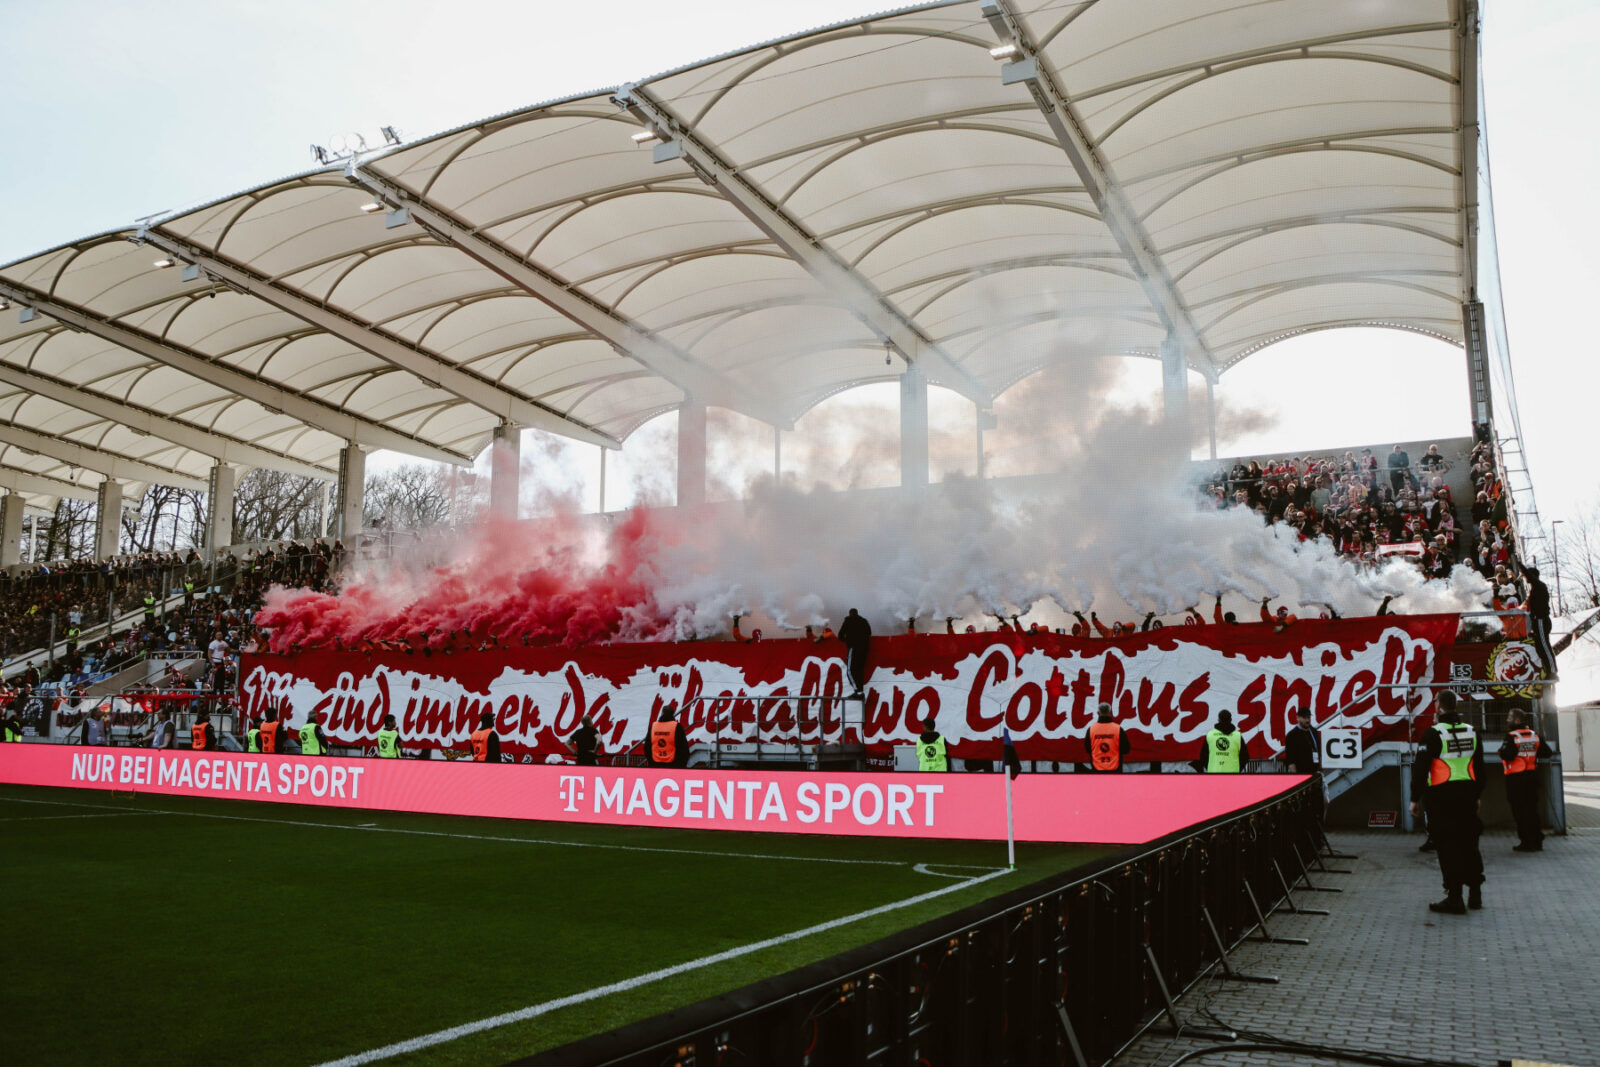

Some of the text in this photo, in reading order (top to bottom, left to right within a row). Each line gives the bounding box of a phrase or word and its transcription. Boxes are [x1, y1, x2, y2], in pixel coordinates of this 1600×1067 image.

[313, 671, 391, 734] sind
[403, 678, 541, 737] immer
[648, 662, 844, 737] überall
[863, 685, 941, 735] wo
[966, 650, 1211, 733] Cottbus
[1237, 634, 1427, 747] spielt
[1326, 738, 1357, 759] C3
[72, 754, 364, 799] NUR BEI MAGENTA SPORT
[595, 777, 788, 821] MAGENTA
[797, 782, 944, 826] SPORT
